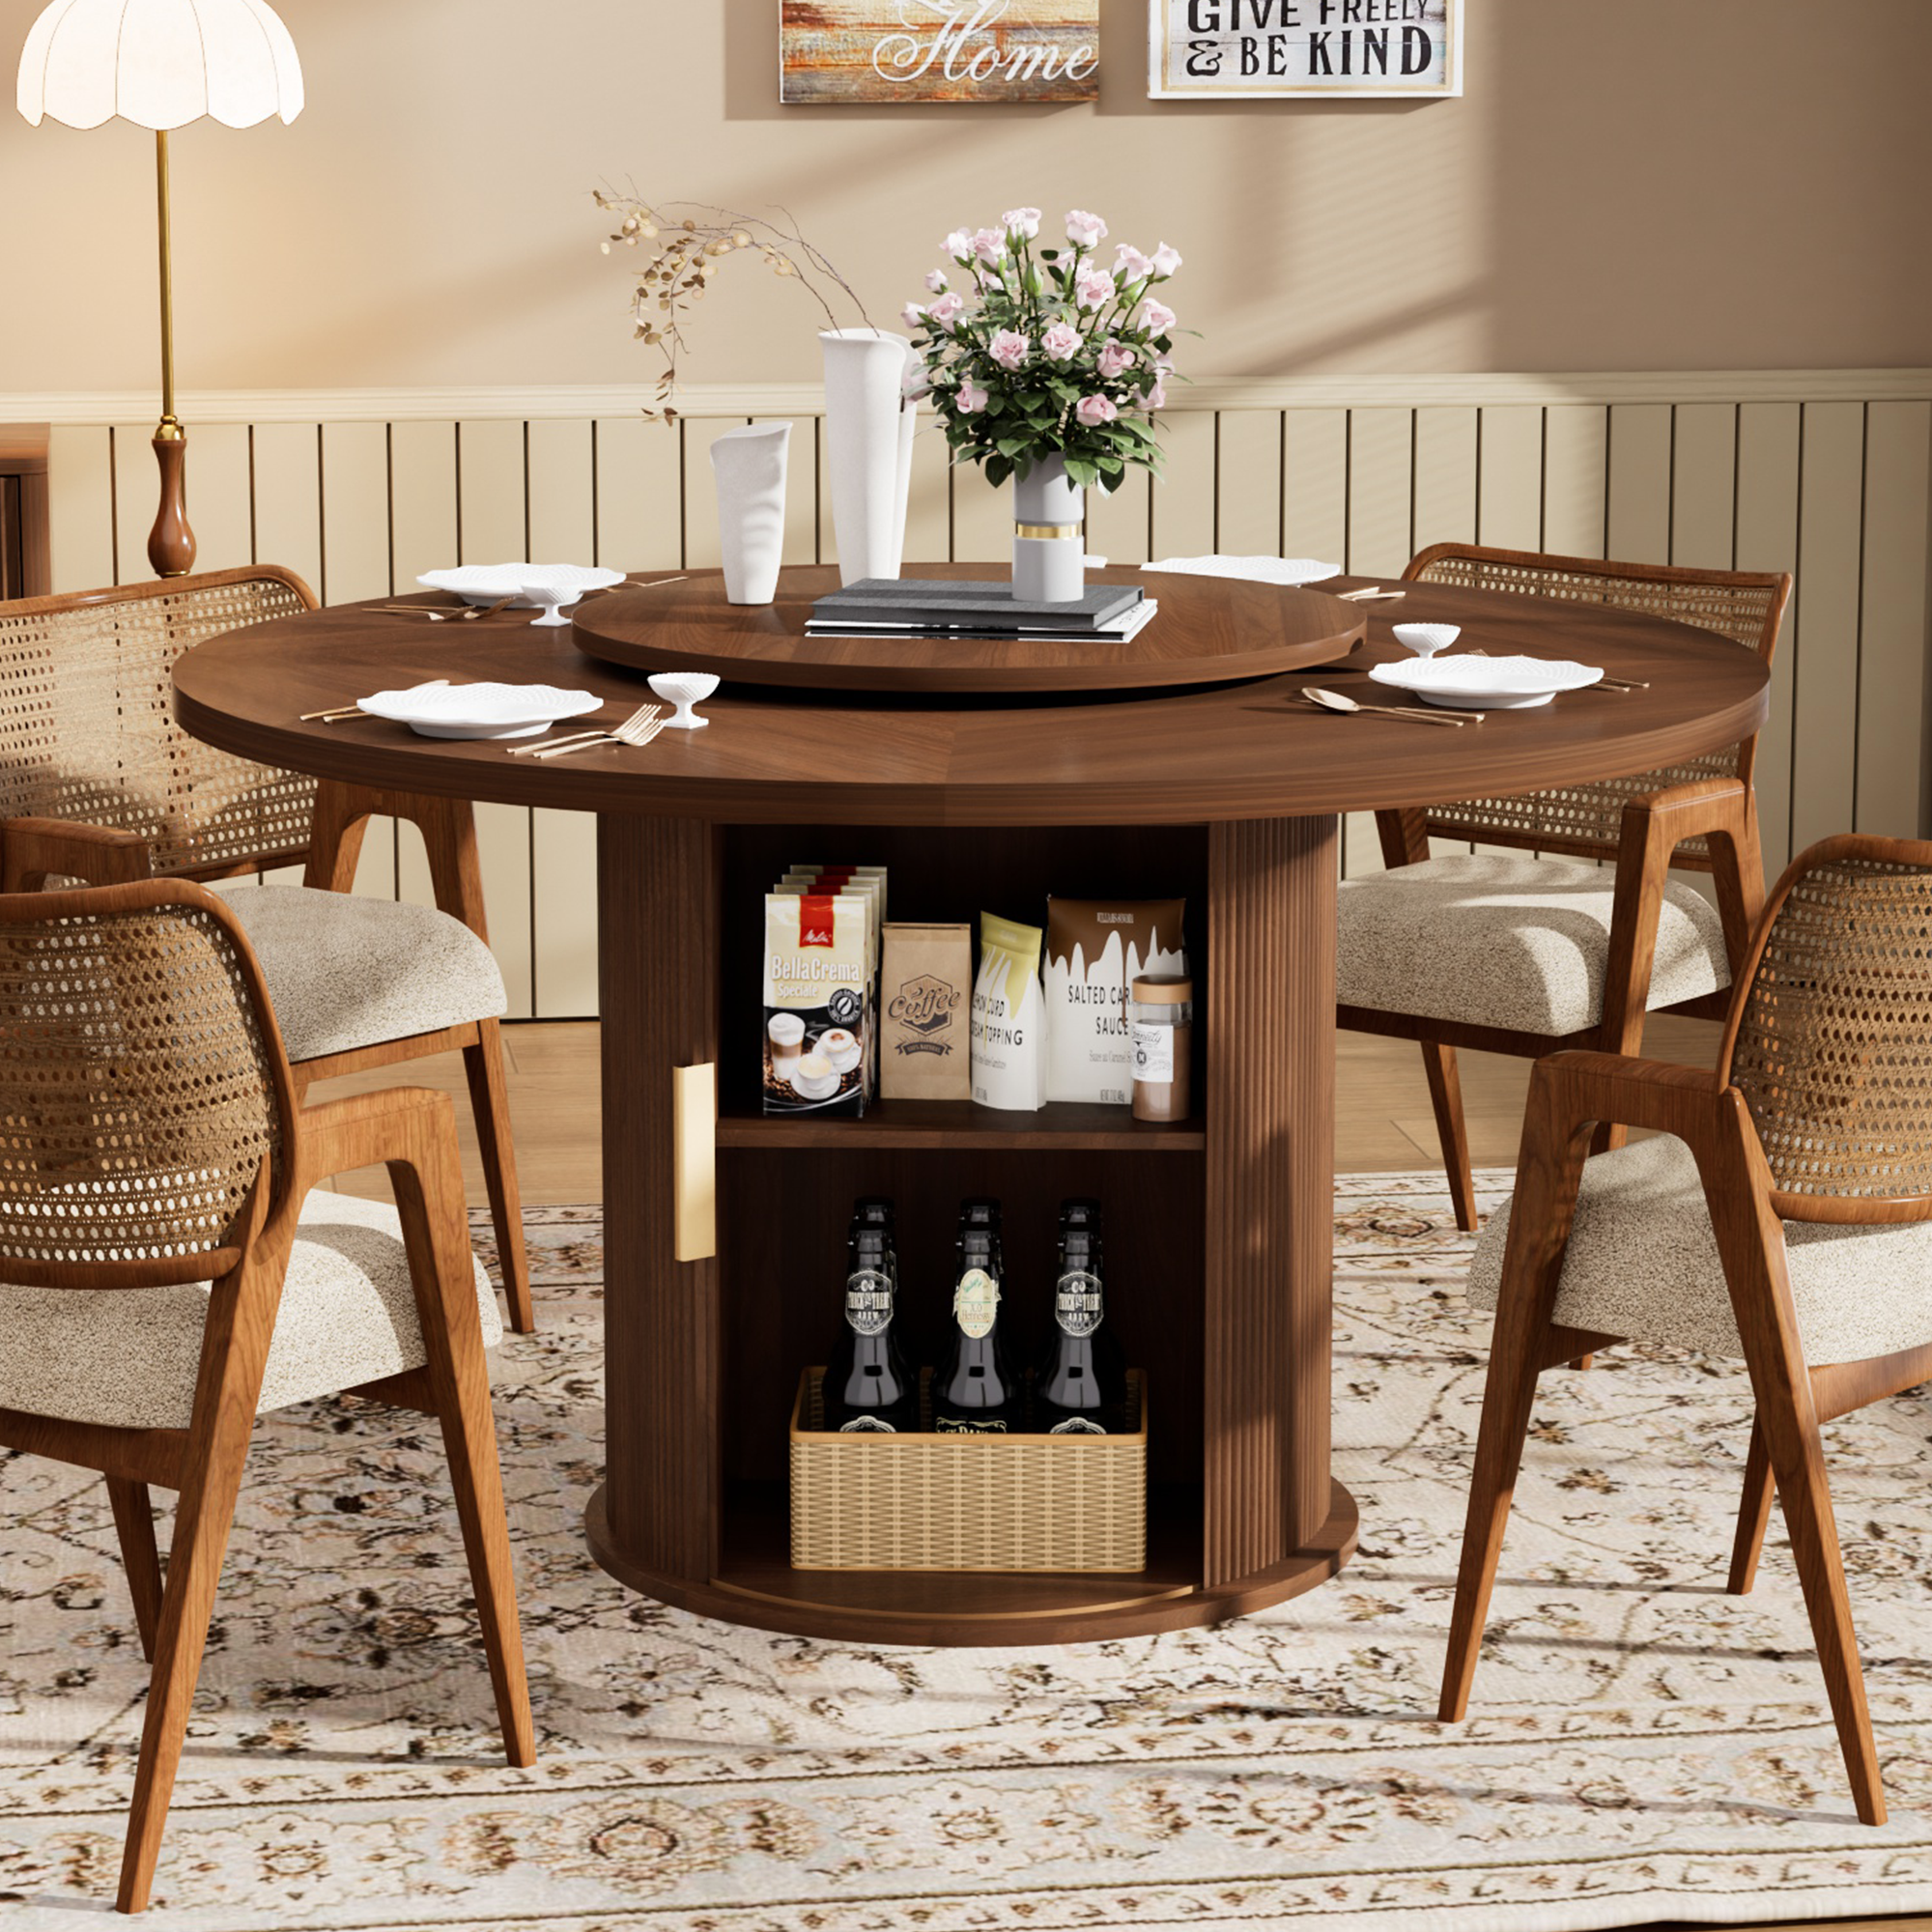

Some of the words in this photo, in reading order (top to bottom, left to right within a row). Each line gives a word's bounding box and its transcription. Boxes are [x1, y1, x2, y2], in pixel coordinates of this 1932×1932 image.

[1187, 0, 1301, 33] GIVE
[1320, 0, 1428, 25] FREELY
[872, 0, 1099, 82] Home
[1186, 40, 1223, 76] &
[1240, 35, 1288, 76] BE
[1308, 26, 1433, 75] KIND
[772, 954, 860, 981] BellaCrema
[778, 983, 818, 999] Speciale
[889, 988, 961, 1019] Coffee
[1068, 985, 1106, 1005] SALTED
[1110, 986, 1133, 1006] CAR
[985, 1025, 1023, 1046] TOPPING
[1095, 1016, 1128, 1036] SAUCE
